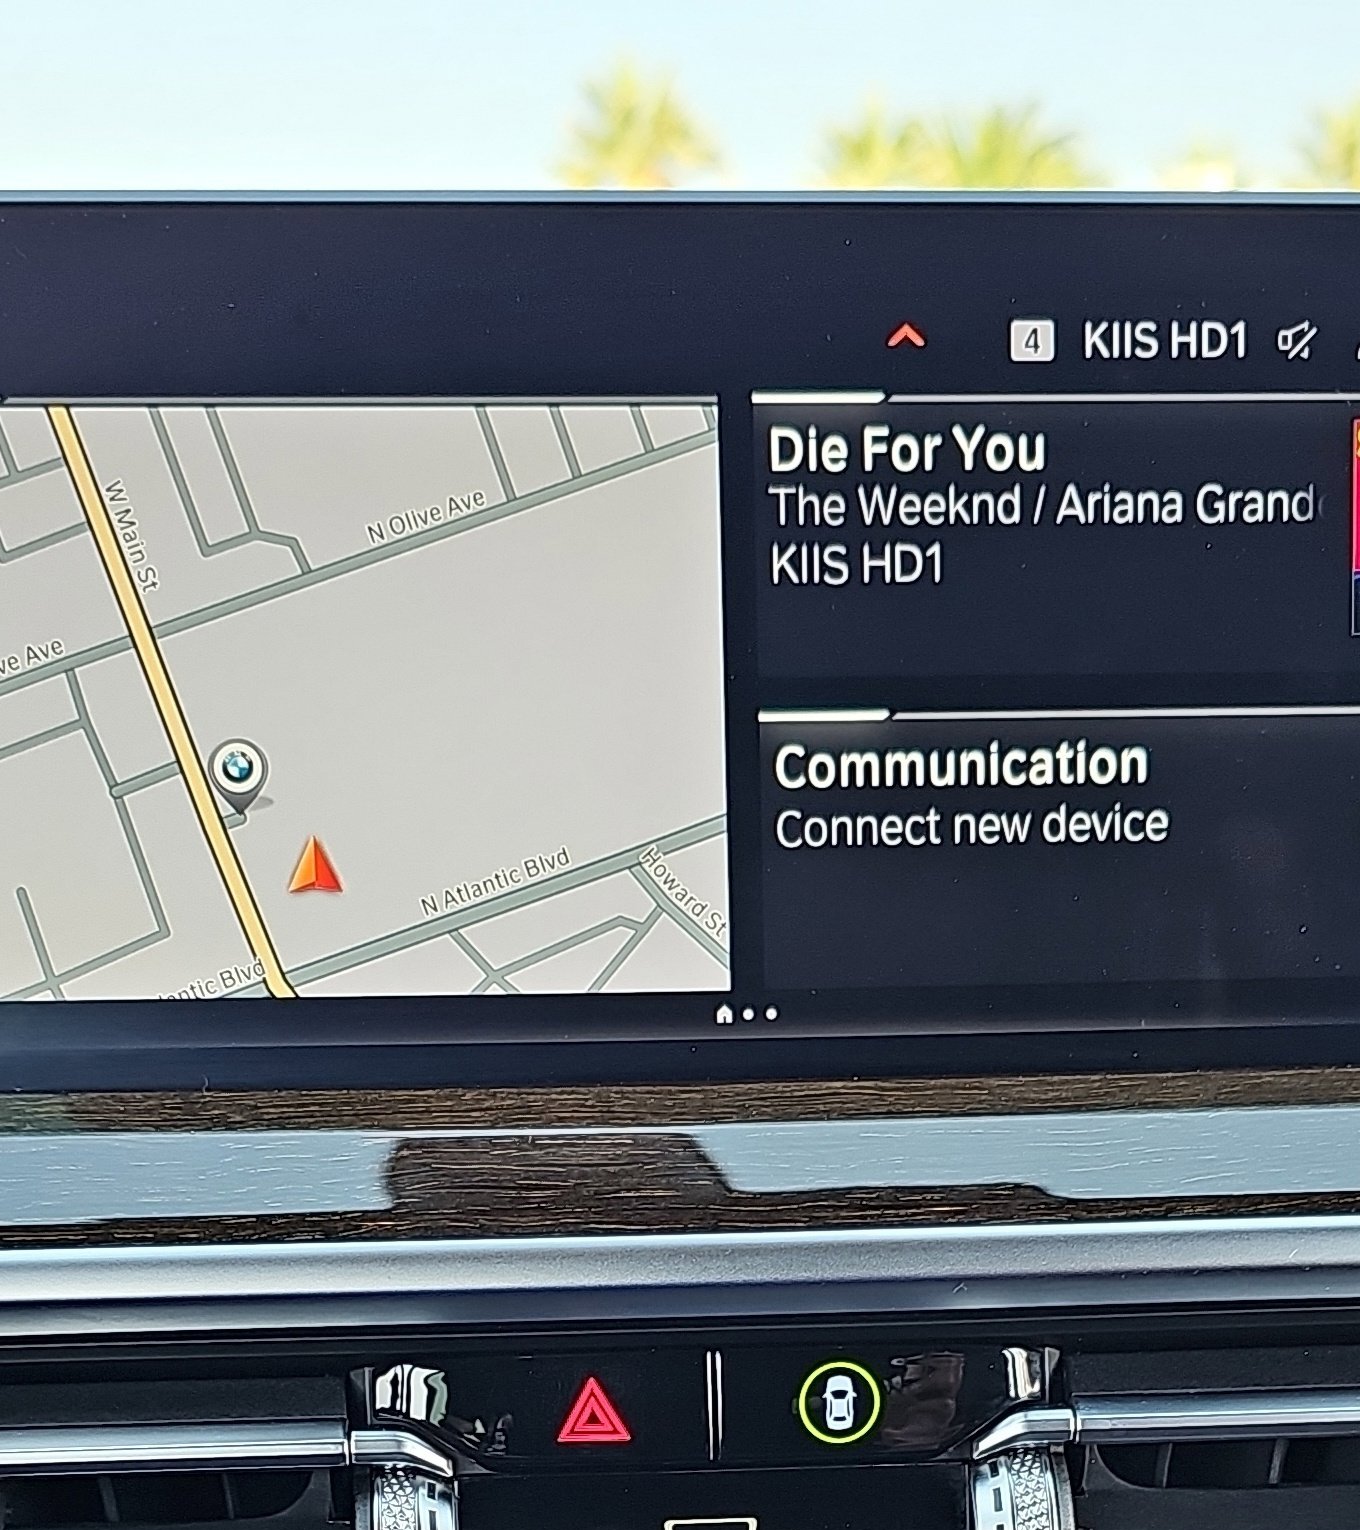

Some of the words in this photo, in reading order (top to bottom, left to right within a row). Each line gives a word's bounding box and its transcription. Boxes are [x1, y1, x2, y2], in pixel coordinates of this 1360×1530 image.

[1023, 327, 1040, 355] 4
[1084, 321, 1159, 359] KIIS
[1171, 320, 1247, 358] HD1
[770, 425, 848, 472] Die
[863, 424, 941, 471] For
[952, 424, 1045, 471] You
[105, 480, 128, 502] W
[768, 484, 845, 525] The
[857, 482, 1021, 525] Weeknd
[1056, 482, 1183, 524] Ariana
[1196, 482, 1324, 523] Grand
[114, 508, 145, 564] Main
[367, 522, 386, 543] N
[389, 503, 442, 536] Olive
[447, 490, 486, 517] Ave
[137, 567, 158, 593] St
[771, 542, 849, 585] KIIS
[862, 542, 942, 584] HD1
[24, 638, 64, 667] Ave
[775, 740, 1148, 790] Communication
[776, 807, 942, 849] Connect
[953, 811, 1031, 845] new
[1041, 803, 1170, 845] device
[421, 895, 438, 916] N
[444, 869, 521, 909] Atlantic
[524, 847, 569, 878] Blvd
[642, 847, 708, 917] Howard
[705, 912, 727, 938] St
[219, 958, 266, 989] Blvd
